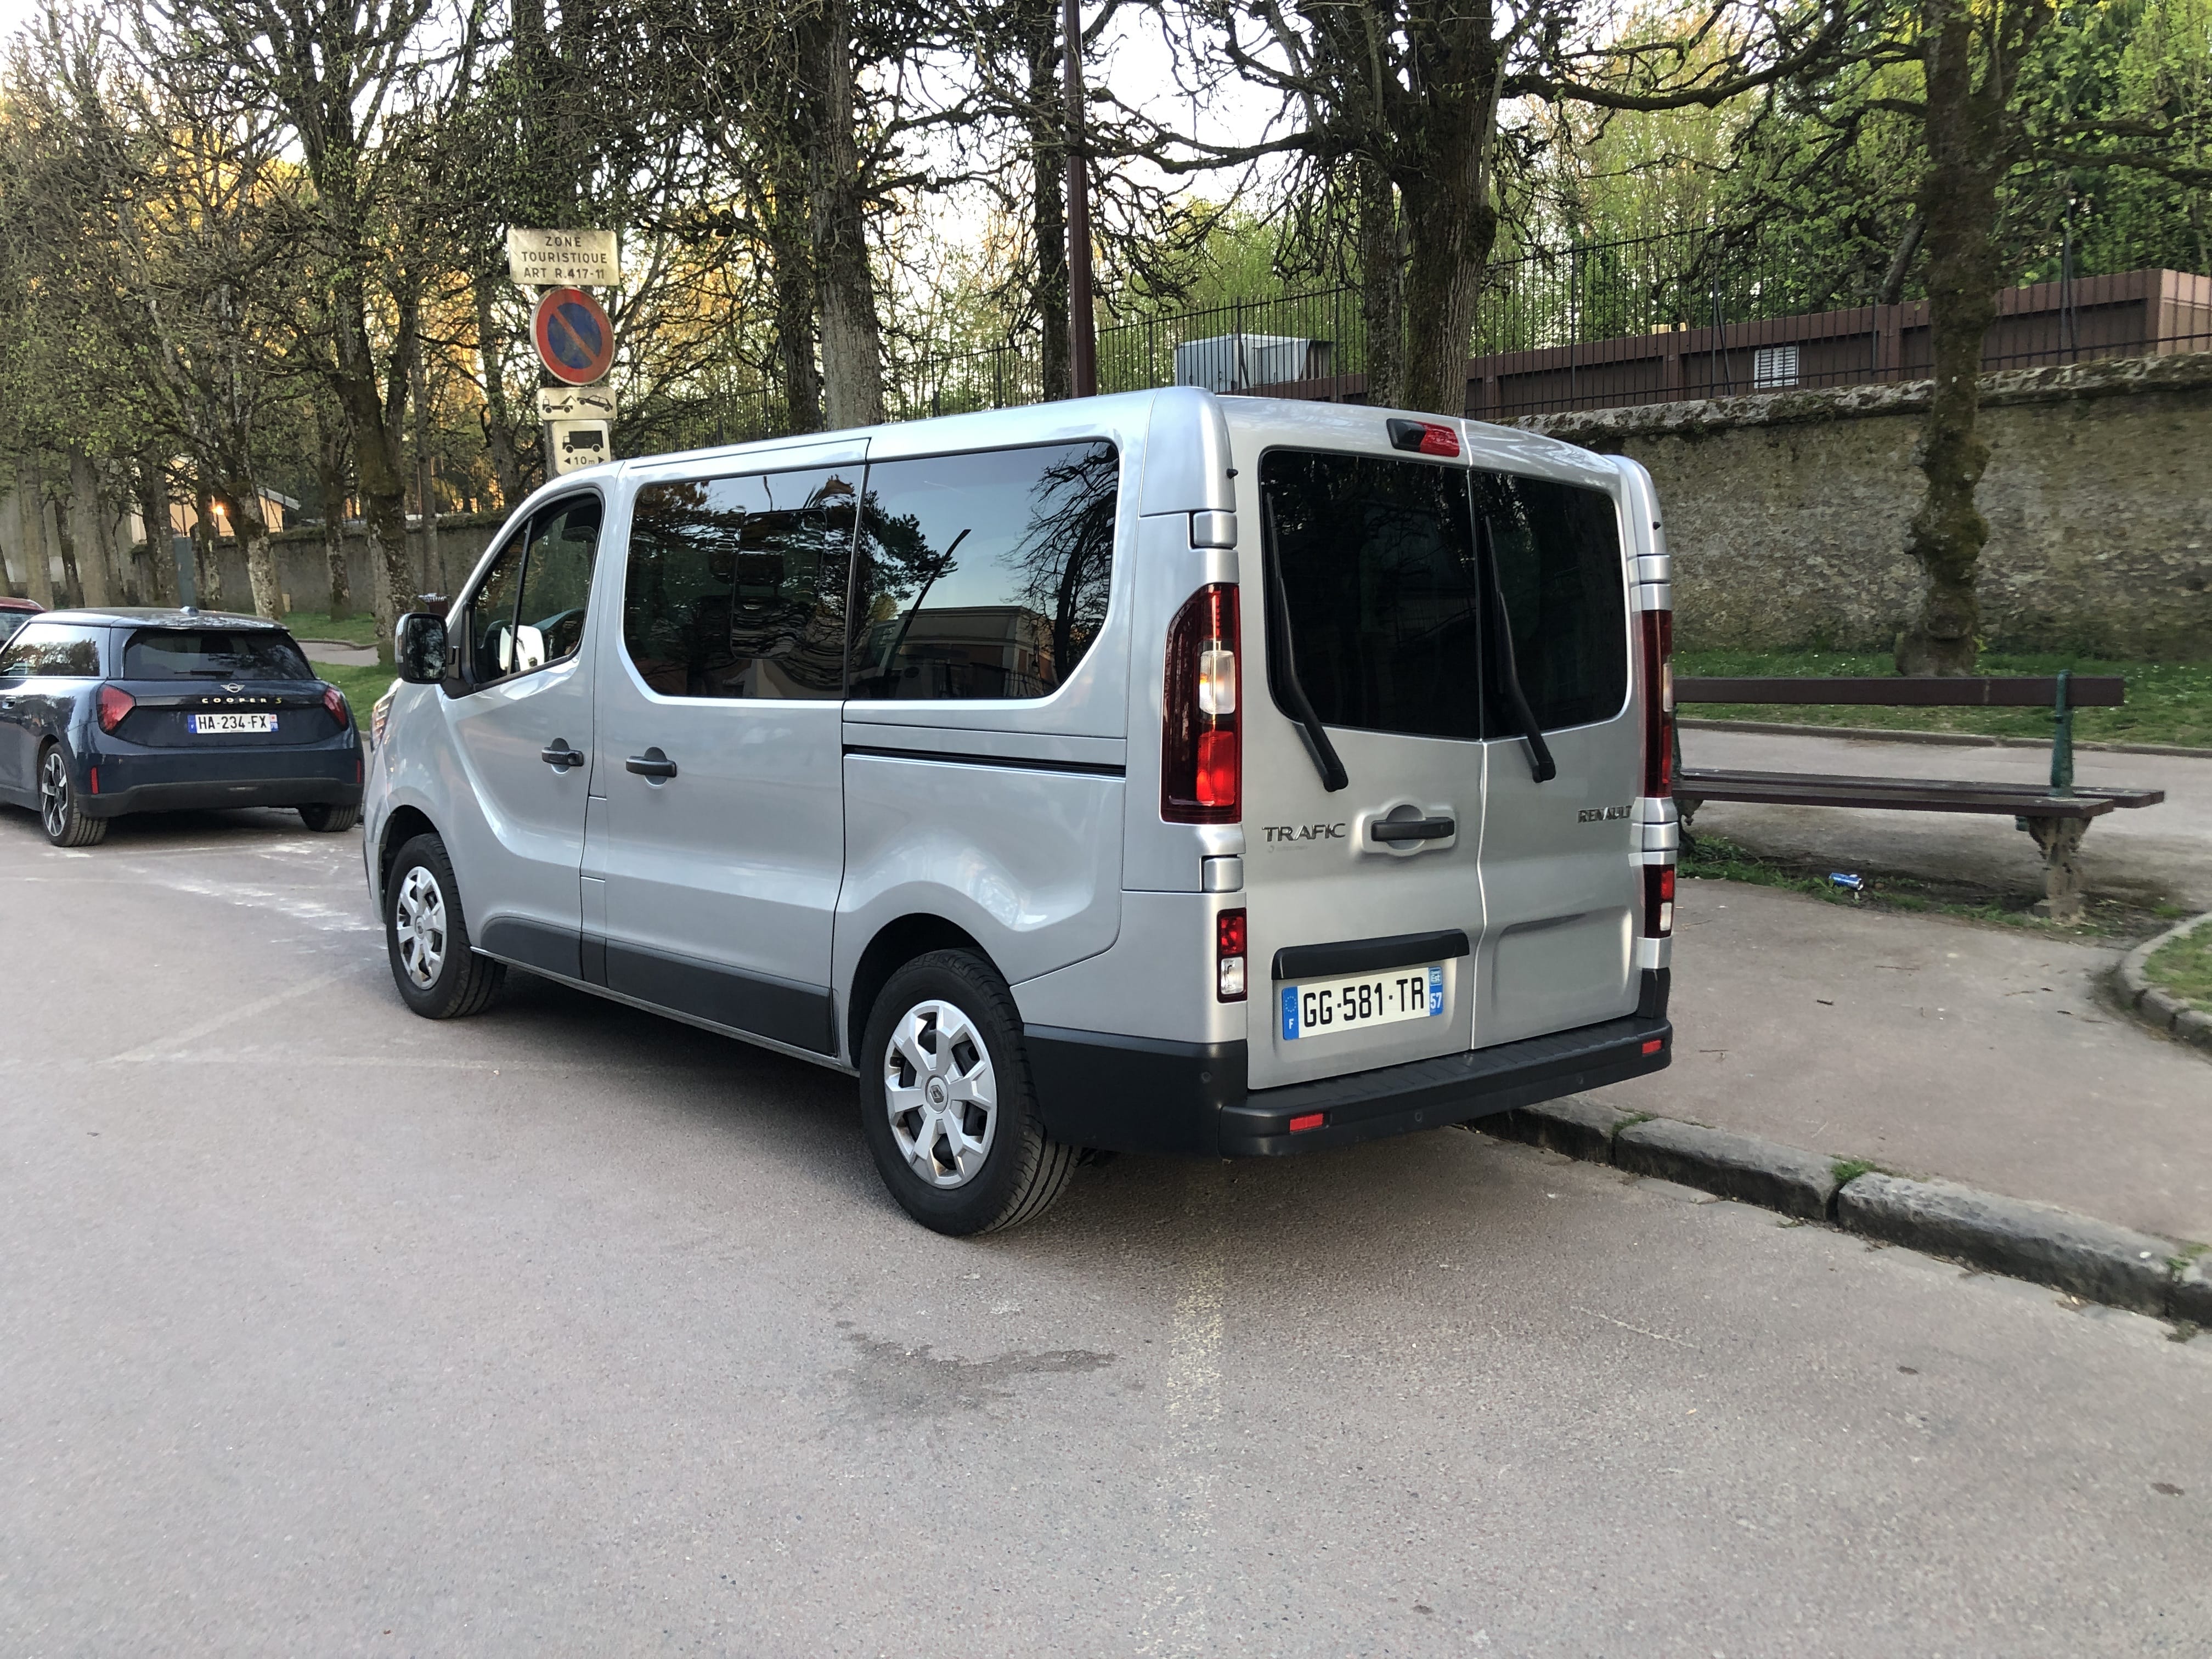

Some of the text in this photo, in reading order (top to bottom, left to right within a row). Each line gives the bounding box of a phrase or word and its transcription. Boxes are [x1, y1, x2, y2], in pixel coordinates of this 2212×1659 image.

[545, 236, 582, 247] ZONE
[522, 251, 607, 264] TOURISTIQUE
[524, 268, 604, 279] ART R.417-11
[198, 715, 267, 730] HA-234-FX
[1577, 805, 1633, 823] RENAULT
[1262, 823, 1346, 842] TRAFIC
[1430, 992, 1442, 1009] 57
[1289, 1018, 1294, 1029] F
